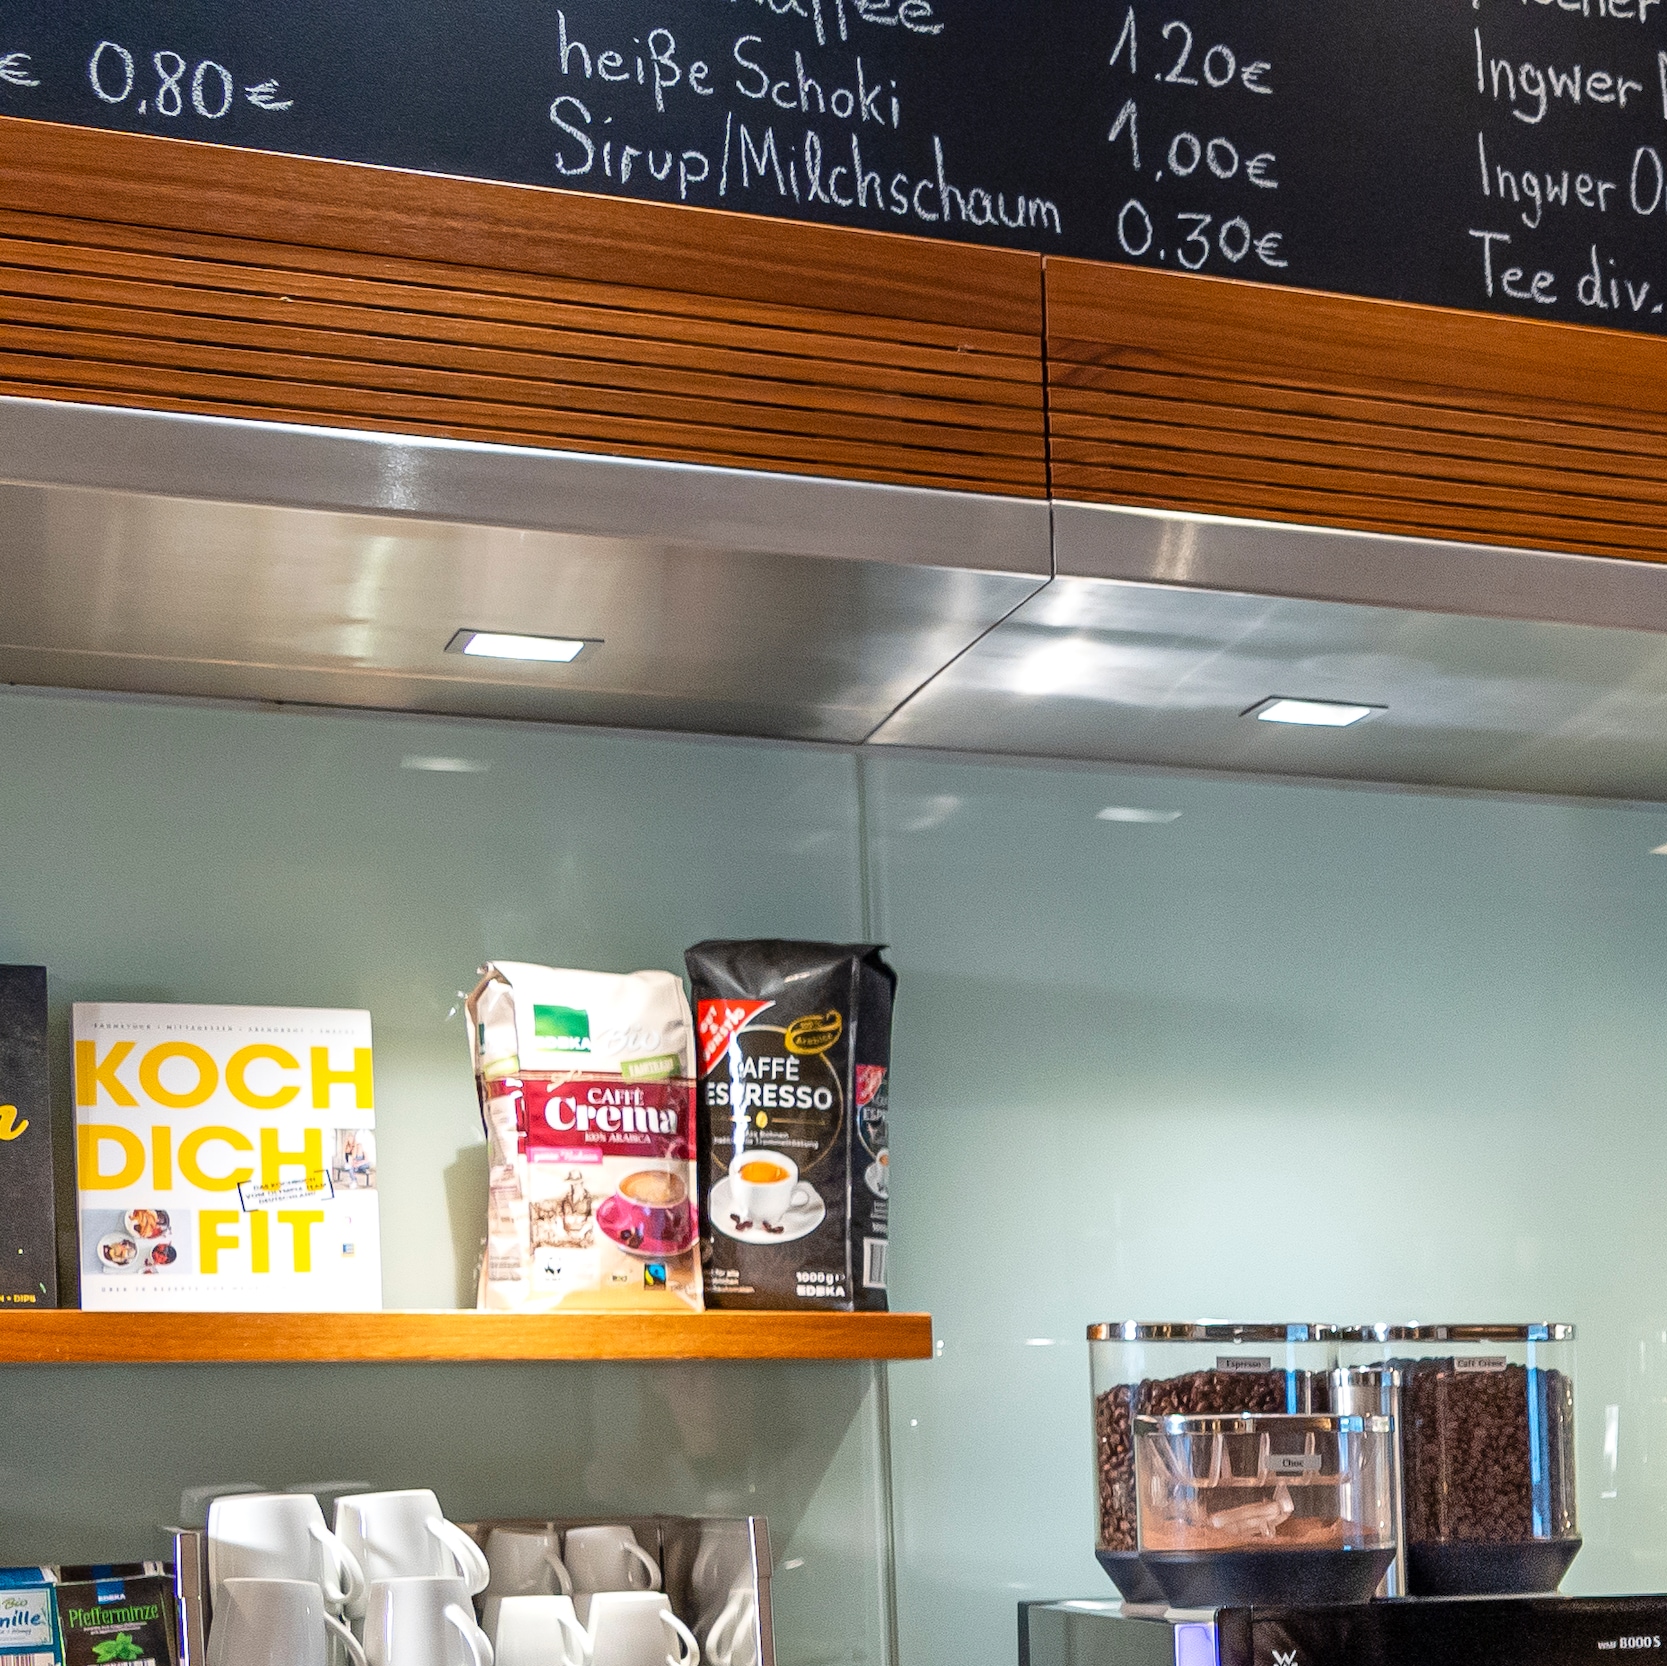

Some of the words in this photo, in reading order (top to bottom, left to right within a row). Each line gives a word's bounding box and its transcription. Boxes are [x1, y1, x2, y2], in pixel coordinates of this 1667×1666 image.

[558, 9, 714, 112] heiße
[733, 35, 902, 129] Schoki
[1474, 27, 1642, 124] Ingwer
[549, 96, 1062, 234] Sirup/Milchschaum
[1477, 131, 1617, 229] Ingwer
[1469, 229, 1557, 303] Tee
[1576, 243, 1663, 314] div.
[75, 1039, 374, 1110] KOCH
[544, 1096, 679, 1135] Crema
[77, 1123, 324, 1193] DICH
[199, 1209, 325, 1275] FIT
[68, 1603, 160, 1629] Pfefferminze
